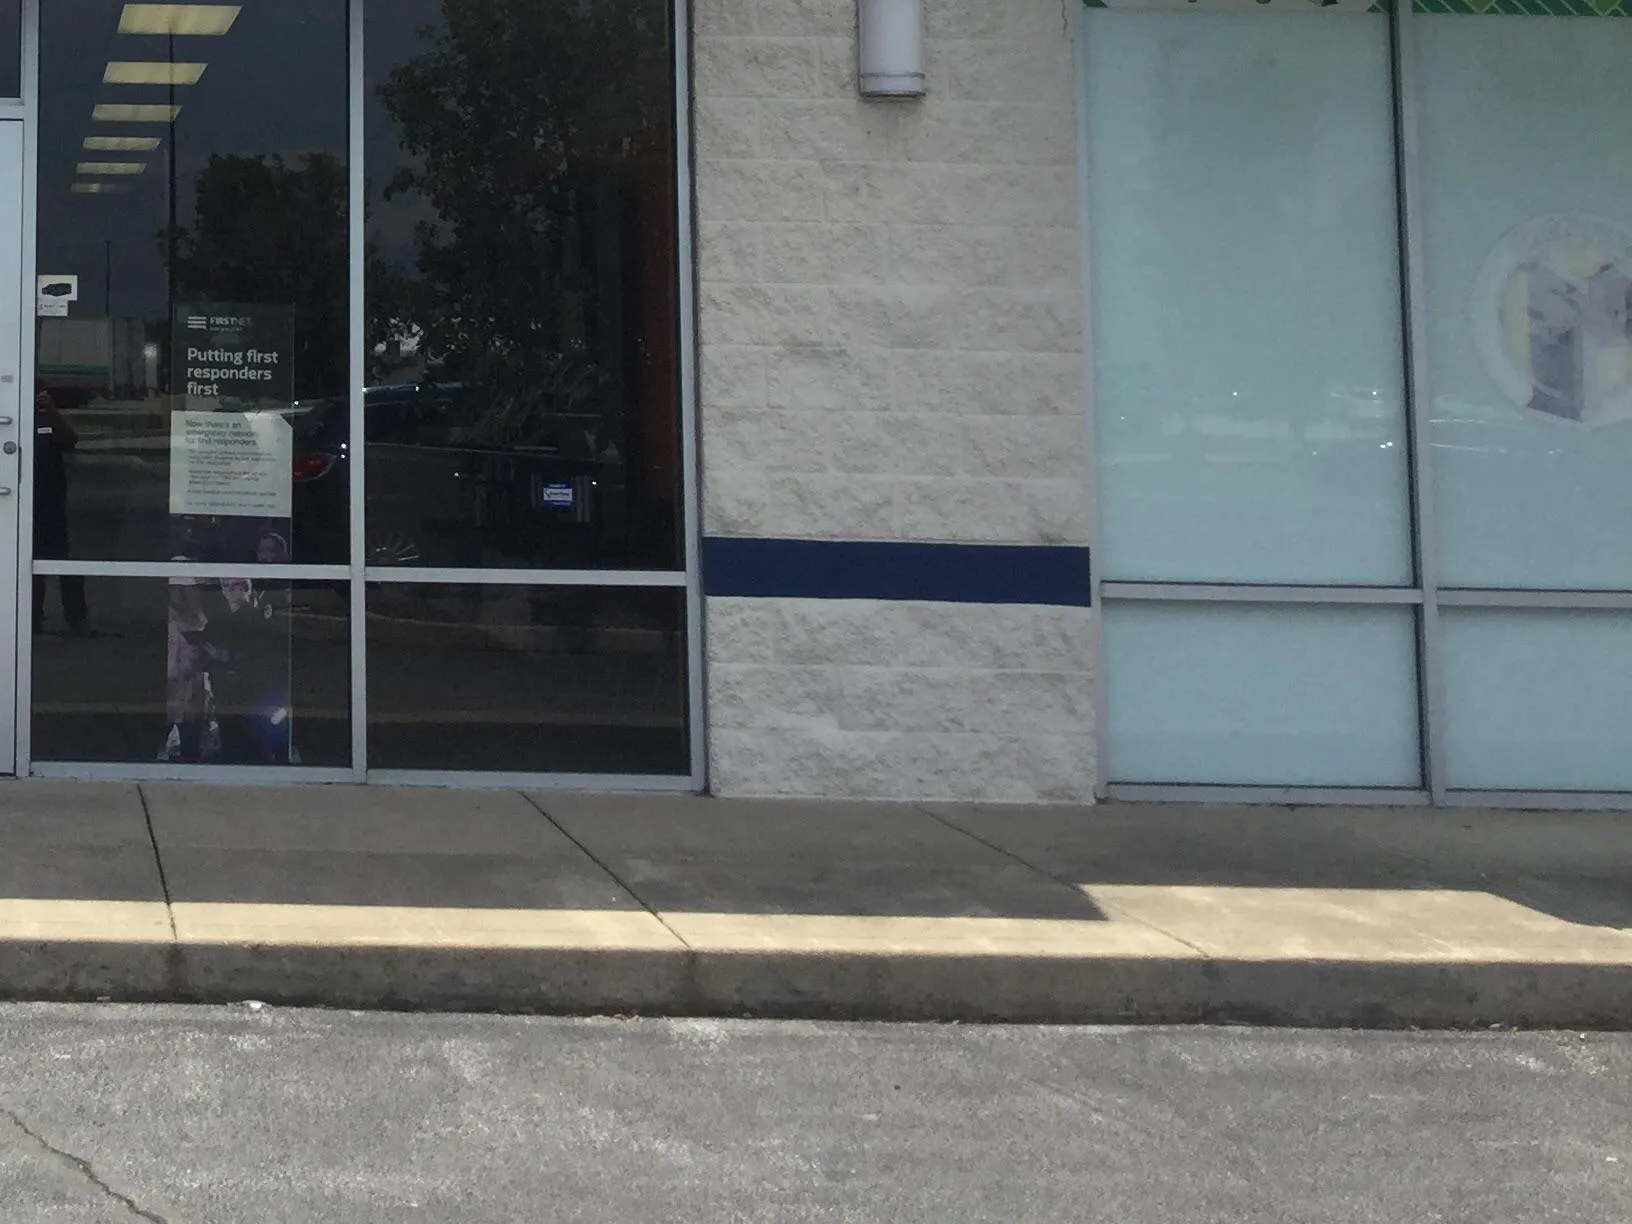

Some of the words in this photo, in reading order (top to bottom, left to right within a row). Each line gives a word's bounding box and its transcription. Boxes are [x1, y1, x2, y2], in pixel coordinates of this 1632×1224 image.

[187, 347, 243, 365] Putting
[246, 348, 279, 364] first
[186, 367, 272, 381] responders
[186, 381, 219, 396] first
